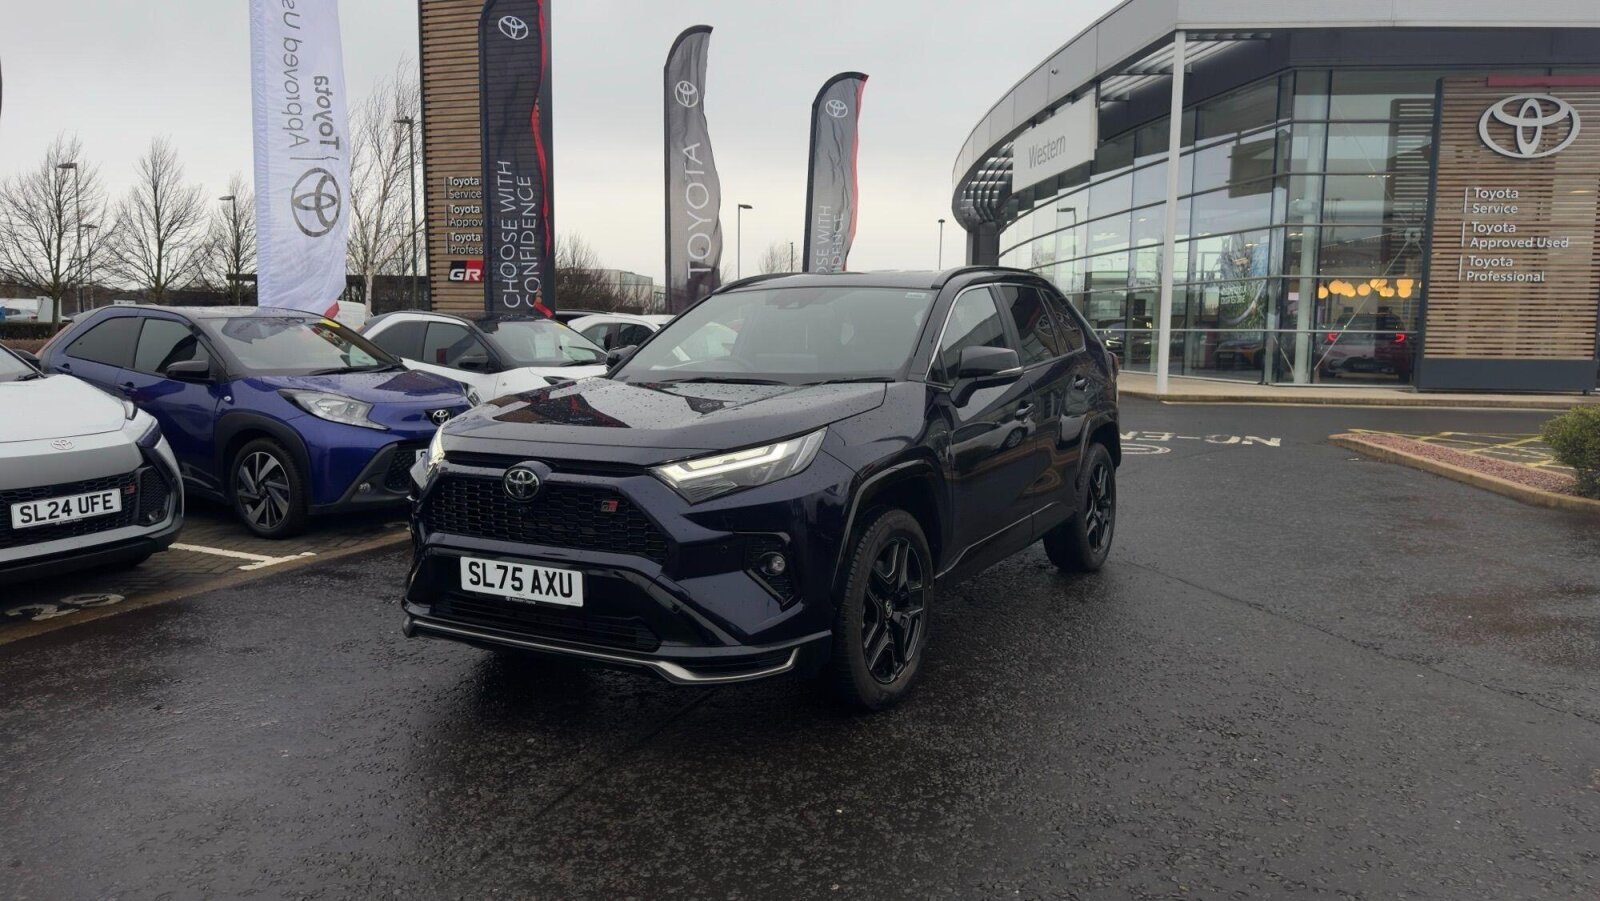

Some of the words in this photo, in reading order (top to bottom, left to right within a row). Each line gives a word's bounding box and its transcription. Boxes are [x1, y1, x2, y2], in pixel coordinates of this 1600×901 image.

[1028, 135, 1066, 169] Western
[448, 176, 480, 188] Toyota
[497, 161, 516, 213] WITH
[449, 189, 482, 199] Service
[1473, 187, 1519, 201] Toyota
[449, 204, 480, 215] Toyota
[683, 142, 712, 279] TOYOTA
[1472, 203, 1518, 214] Service
[817, 205, 831, 244] WITH
[1471, 221, 1517, 235] Toyota
[450, 232, 481, 244] Toyota
[516, 175, 541, 307] CONFIDENCE
[1470, 237, 1533, 250] Approved
[1536, 237, 1569, 248] Used
[500, 219, 520, 308] CHOOSE
[1468, 255, 1514, 269] Toyota
[449, 268, 481, 281] GR
[1466, 271, 1545, 282] Professional
[20, 499, 72, 524] SL24
[78, 493, 113, 514] UFE
[468, 561, 524, 592] SL75
[530, 569, 573, 598] AXU
